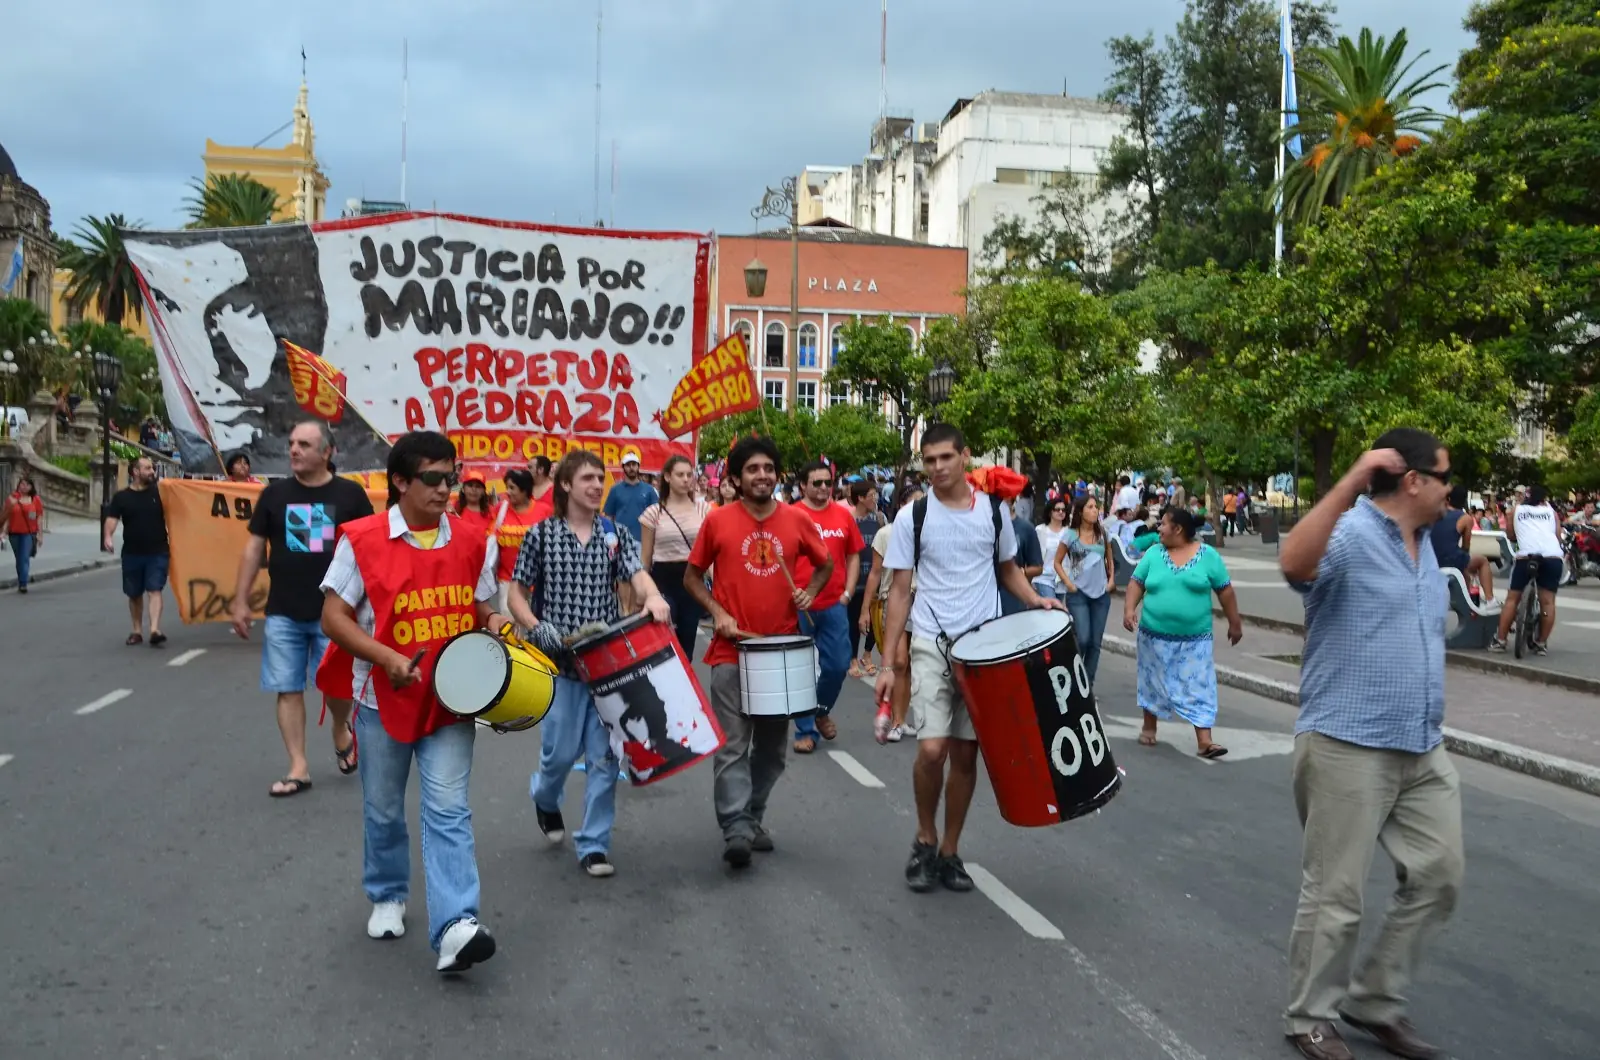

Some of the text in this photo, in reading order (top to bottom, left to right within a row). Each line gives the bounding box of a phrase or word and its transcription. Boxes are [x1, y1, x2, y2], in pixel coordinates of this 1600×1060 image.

[349, 235, 566, 283] JUSTICIA
[808, 277, 878, 293] PLAZA
[359, 278, 686, 345] MARIANO!!
[413, 343, 634, 390] PERPETUA
[405, 385, 640, 435] A PEDRAZA
[449, 434, 514, 459] TIDO
[392, 613, 474, 645] OBREO
